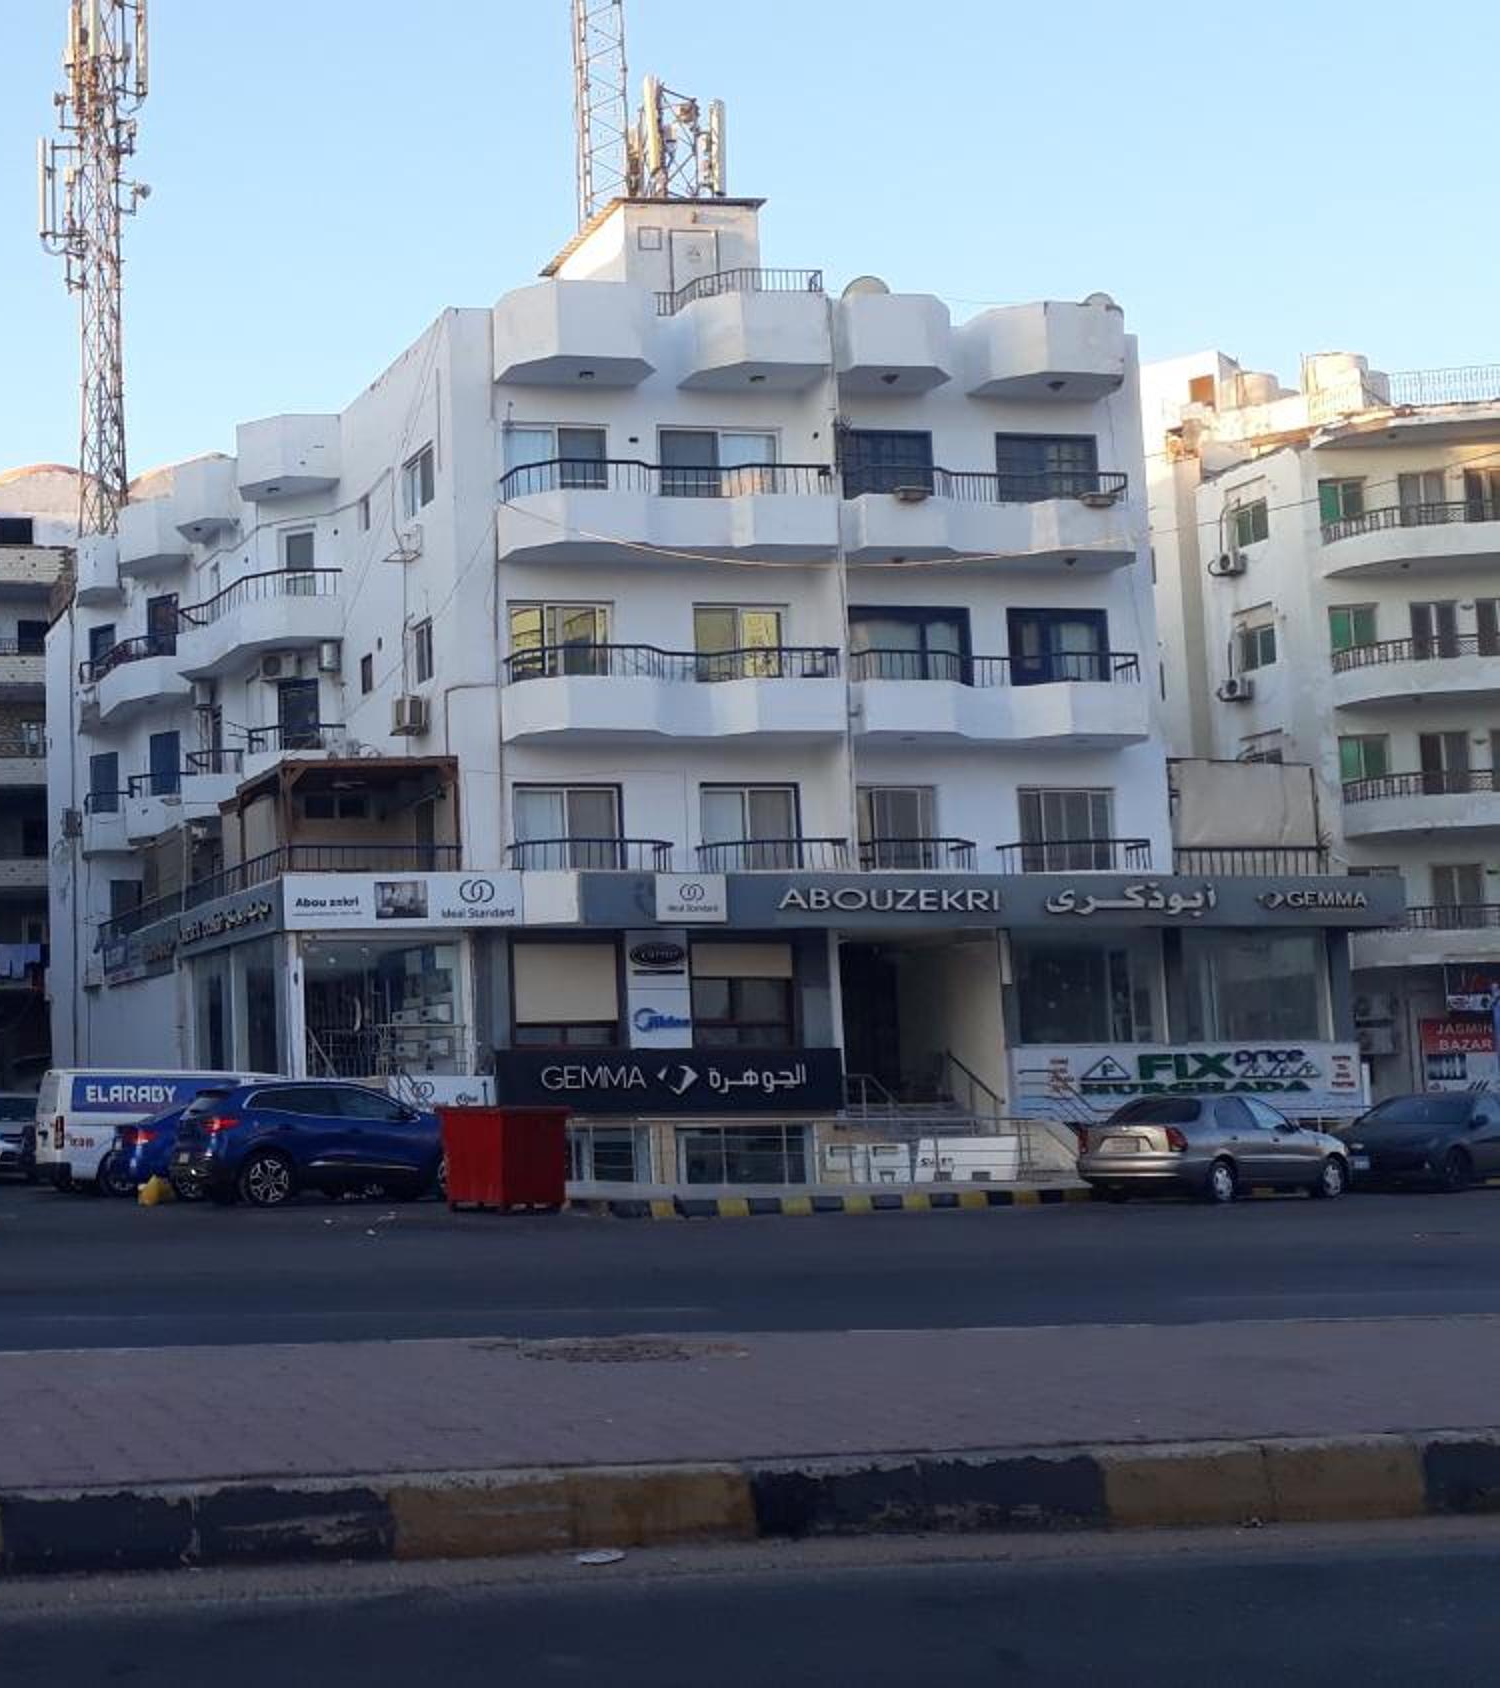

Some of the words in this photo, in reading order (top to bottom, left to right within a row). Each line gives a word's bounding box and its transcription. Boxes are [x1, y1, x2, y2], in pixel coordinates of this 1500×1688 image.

[295, 897, 327, 908] Abou
[777, 887, 1001, 912] ABOUZEKRI
[1285, 890, 1368, 908] GEMMA
[1439, 1039, 1493, 1051] BAZAR
[1137, 1052, 1236, 1080] FIX
[540, 1065, 648, 1090] GEMMA
[707, 1063, 808, 1094] الجوهرة
[85, 1085, 178, 1104] ELARABY
